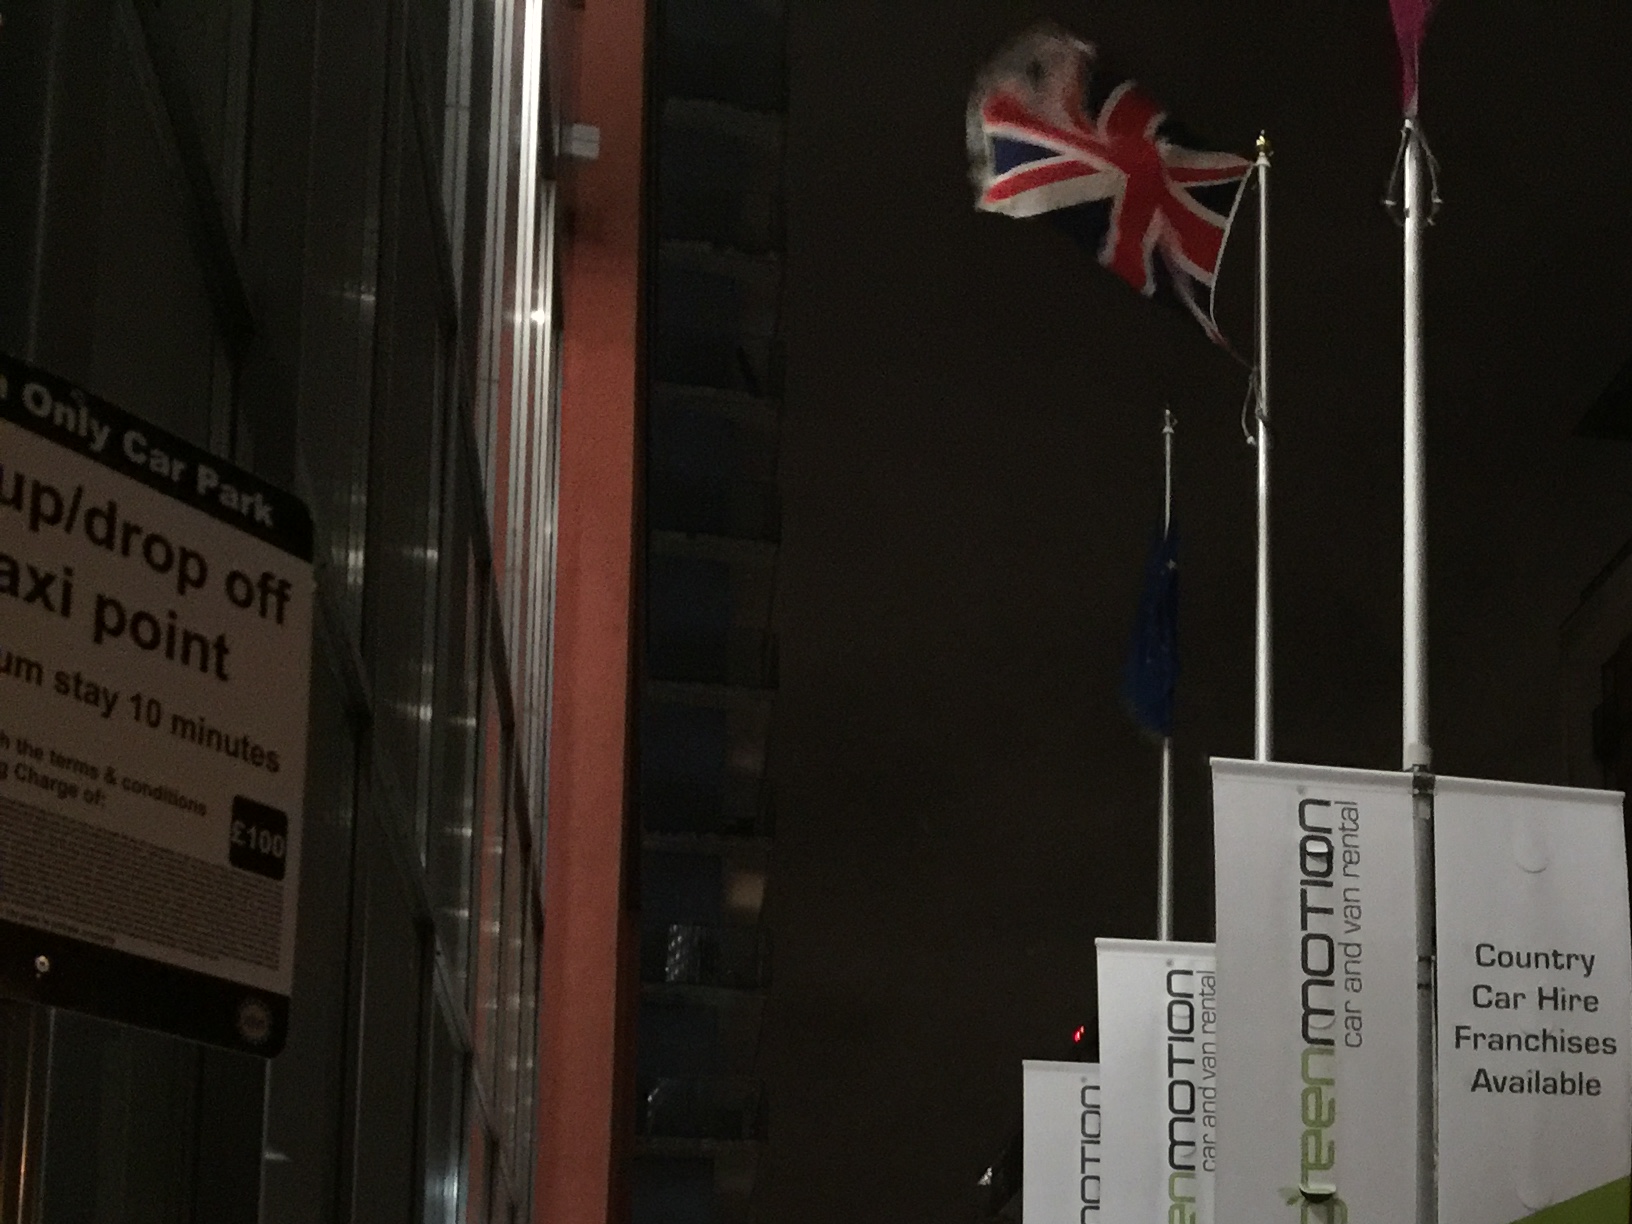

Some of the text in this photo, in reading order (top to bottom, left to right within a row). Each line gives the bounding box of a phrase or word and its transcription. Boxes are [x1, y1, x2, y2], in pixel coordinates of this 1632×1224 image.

[22, 382, 111, 452] Only
[122, 430, 188, 482] Car
[196, 464, 275, 528] Park
[225, 570, 293, 625] off
[93, 594, 230, 682] point
[54, 670, 118, 718] stay
[130, 693, 162, 728] 10
[171, 713, 281, 773] minutes
[231, 820, 287, 860] £100
[1334, 801, 1363, 1048] car and van rental
[1475, 943, 1596, 978] Country
[1472, 984, 1599, 1012] Car Hire
[1455, 1025, 1617, 1055] Franchises
[1196, 970, 1217, 1172] car and van rental
[1470, 1068, 1602, 1096] Available
